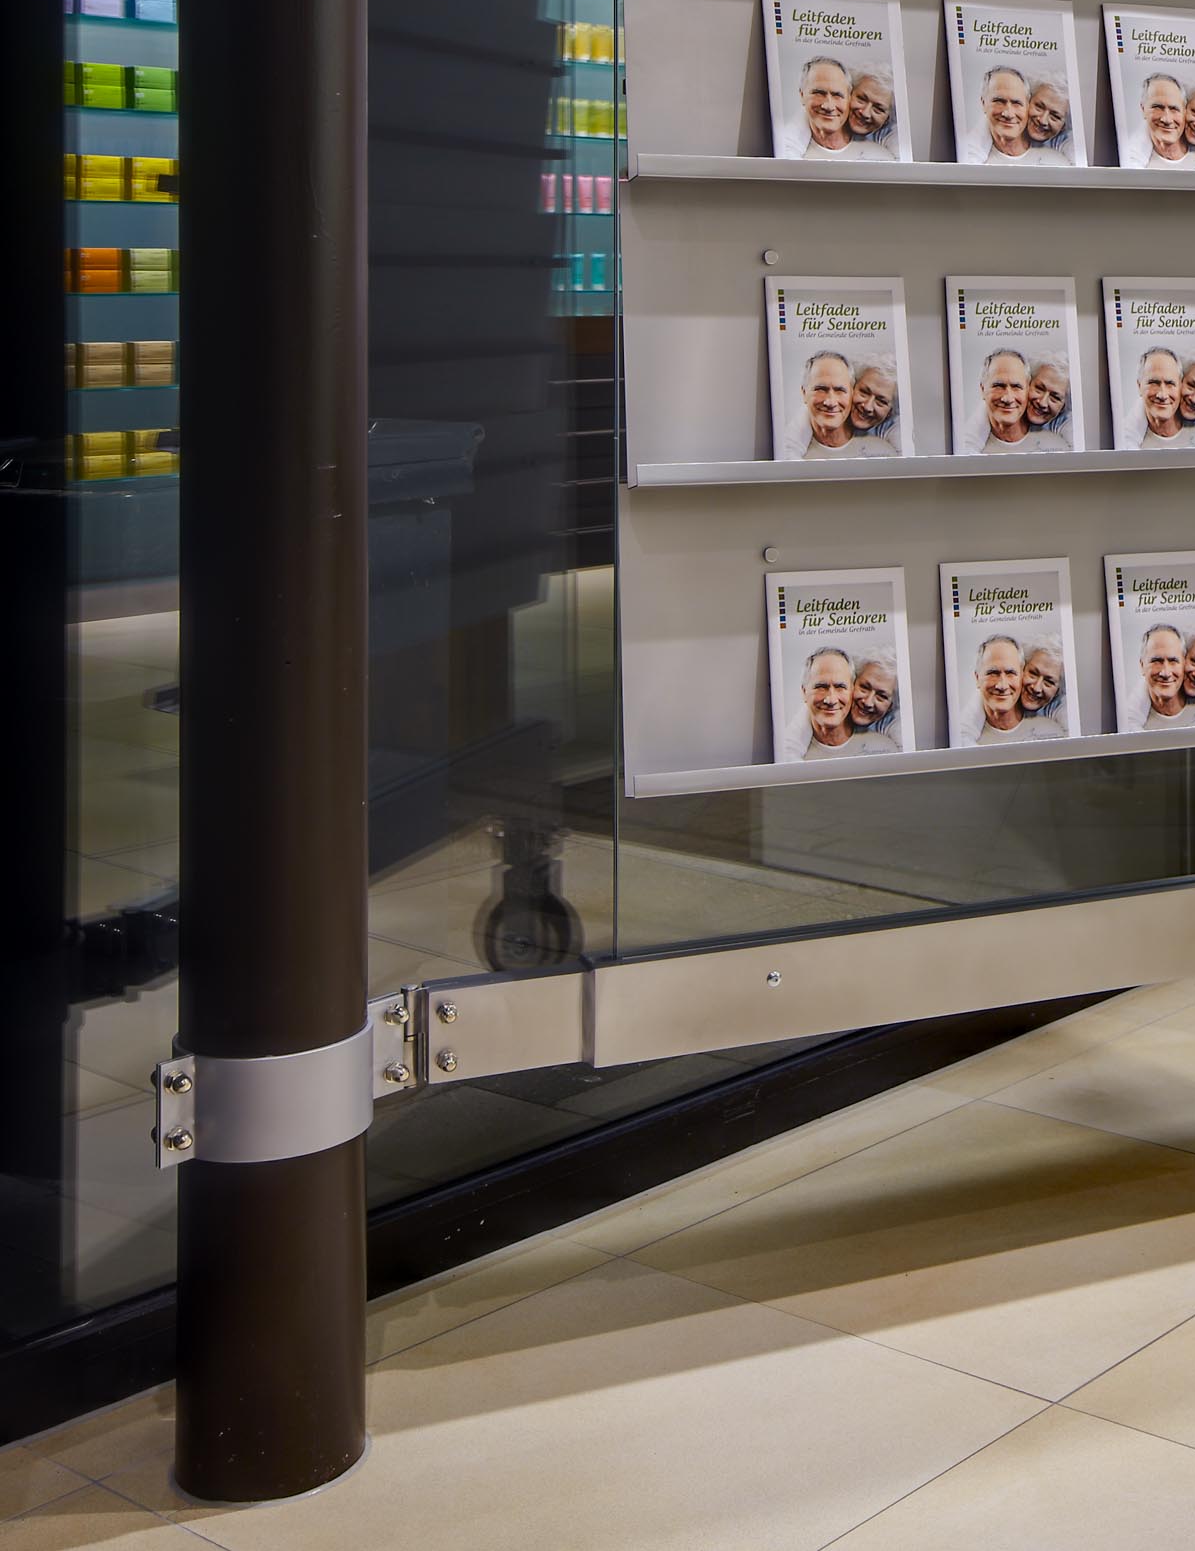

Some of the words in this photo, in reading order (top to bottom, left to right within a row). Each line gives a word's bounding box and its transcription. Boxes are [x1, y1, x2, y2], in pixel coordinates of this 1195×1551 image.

[792, 8, 856, 26] Leitfaden
[798, 23, 821, 38] für
[823, 24, 883, 41] Senioren
[973, 19, 1033, 36] Leitfaden
[979, 33, 1000, 48] für
[1002, 35, 1058, 51] Senioren
[1131, 28, 1188, 44] Leitfaden
[1137, 42, 1157, 55] für
[796, 302, 860, 318] Leitfaden
[975, 301, 1036, 317] Leitfaden
[1130, 301, 1186, 316] Leitfaden
[801, 317, 824, 332] für
[827, 317, 887, 331] Senioren
[980, 316, 1002, 331] für
[1004, 315, 1060, 329] Senioren
[1136, 315, 1156, 329] für
[1132, 577, 1188, 593] Leitfaden
[968, 586, 1029, 603] Leitfaden
[1138, 592, 1158, 608] für
[796, 597, 861, 614] Leitfaden
[974, 602, 996, 618] für
[998, 599, 1054, 615] Senioren
[802, 613, 825, 630] für
[827, 611, 887, 627] Senioren
